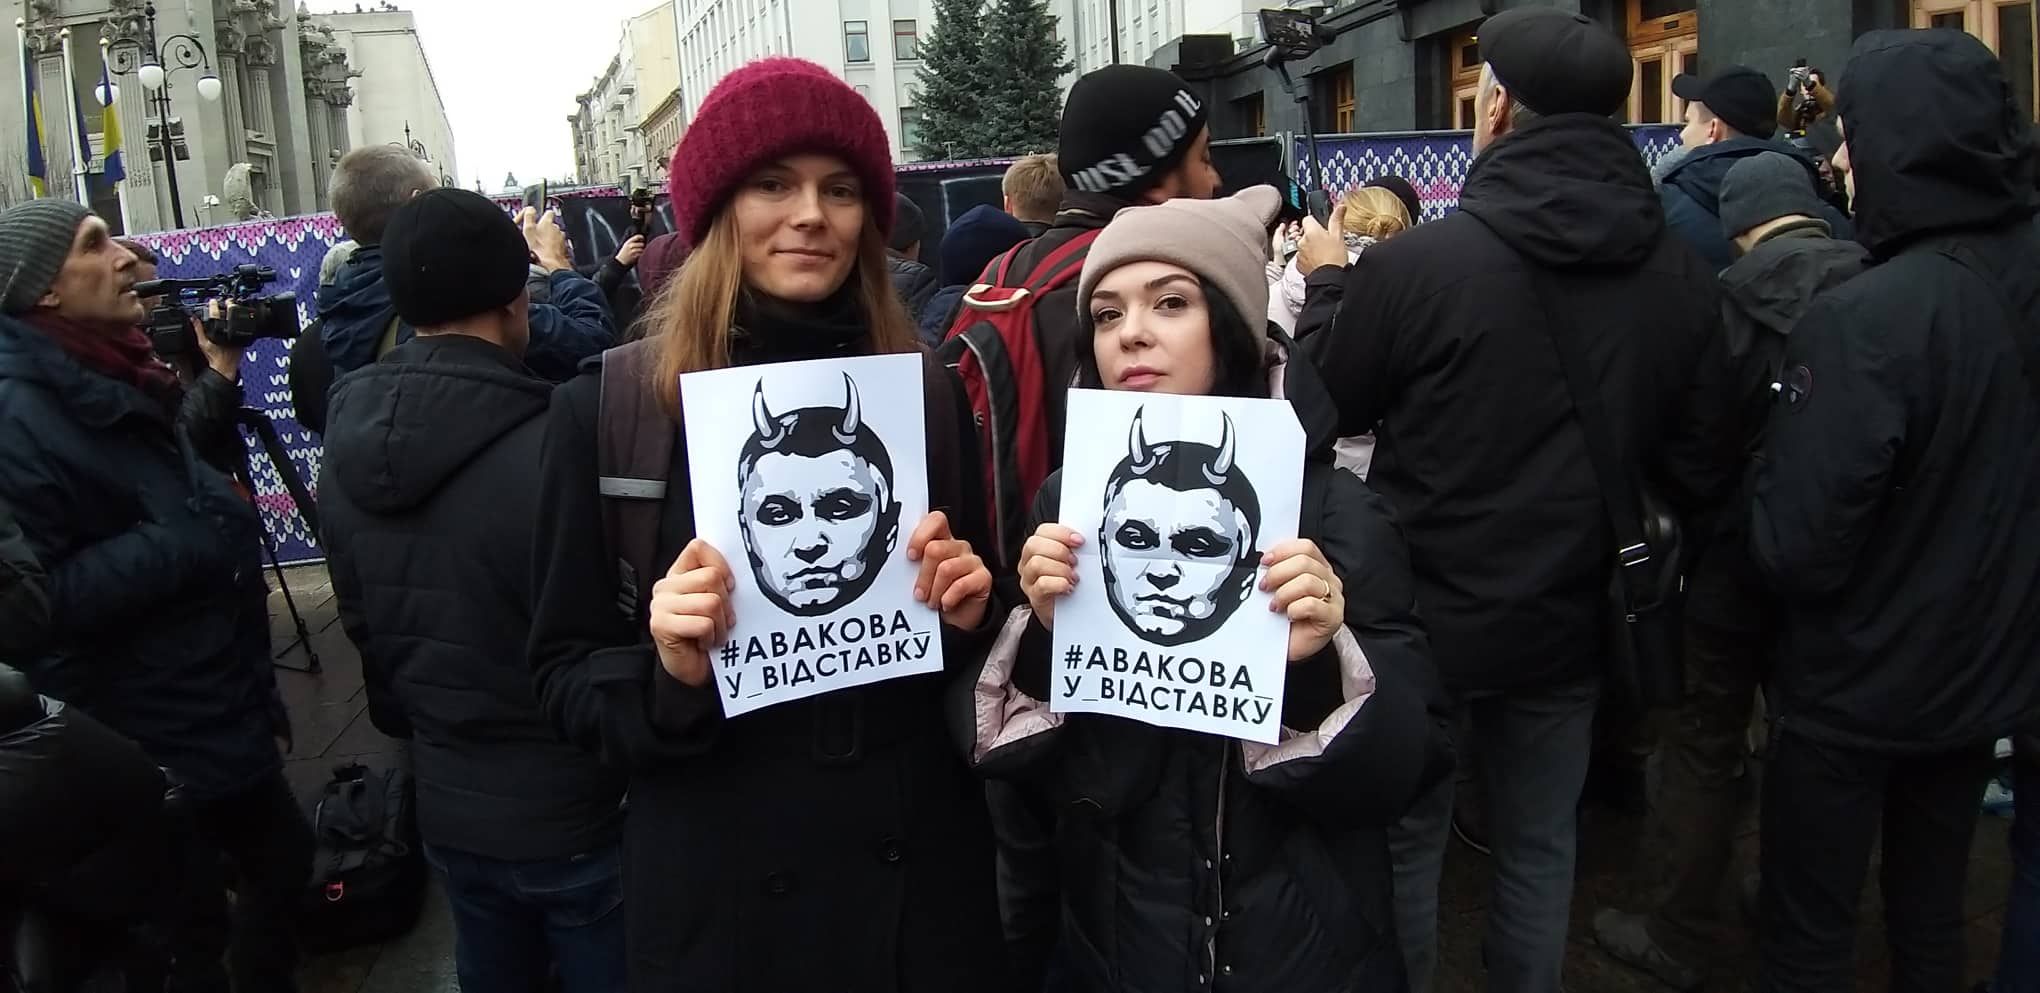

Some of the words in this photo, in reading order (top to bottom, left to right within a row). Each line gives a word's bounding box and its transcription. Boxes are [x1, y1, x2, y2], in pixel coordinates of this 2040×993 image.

[720, 609, 931, 669] #АВАКОВА_
[724, 635, 931, 699] У_ВІДСТАВКУ
[1062, 675, 1273, 725] У_ВІДСТАВКУ
[1063, 644, 1274, 700] #АВАКОВА_
